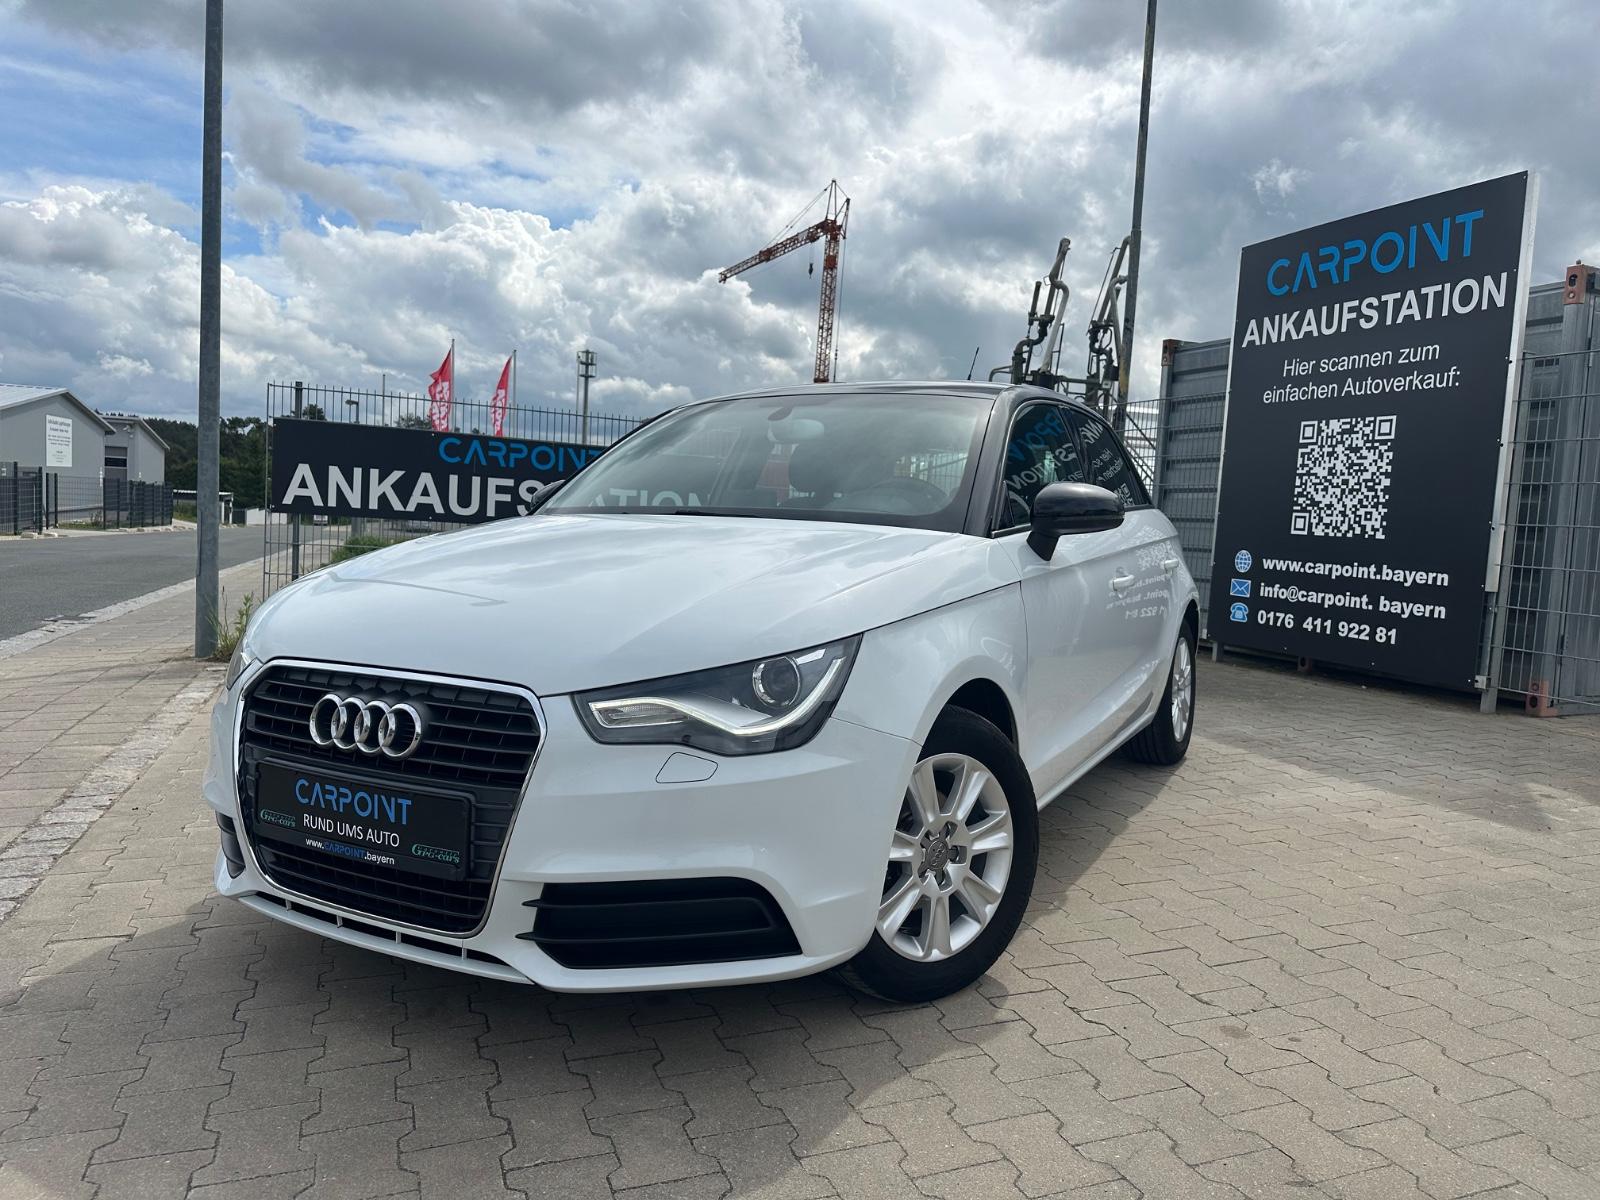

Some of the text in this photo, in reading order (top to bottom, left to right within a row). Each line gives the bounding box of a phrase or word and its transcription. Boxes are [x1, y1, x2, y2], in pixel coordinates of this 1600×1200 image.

[1266, 209, 1484, 296] CARPOINT
[1242, 271, 1508, 348] ANKAUFSTATION
[1283, 344, 1440, 377] Hier scannen zum
[1263, 368, 1461, 404] einfachen Autoverkauf:
[1262, 557, 1449, 588] www.carpoint.bayern
[1260, 583, 1446, 620] info@carpoint. bayern
[1257, 610, 1397, 645] 0176 411 922 81
[295, 779, 412, 825] CARPOINT
[303, 813, 400, 847] RUND UMS AUTO
[305, 838, 395, 865] www.CARPOINT.bayern
